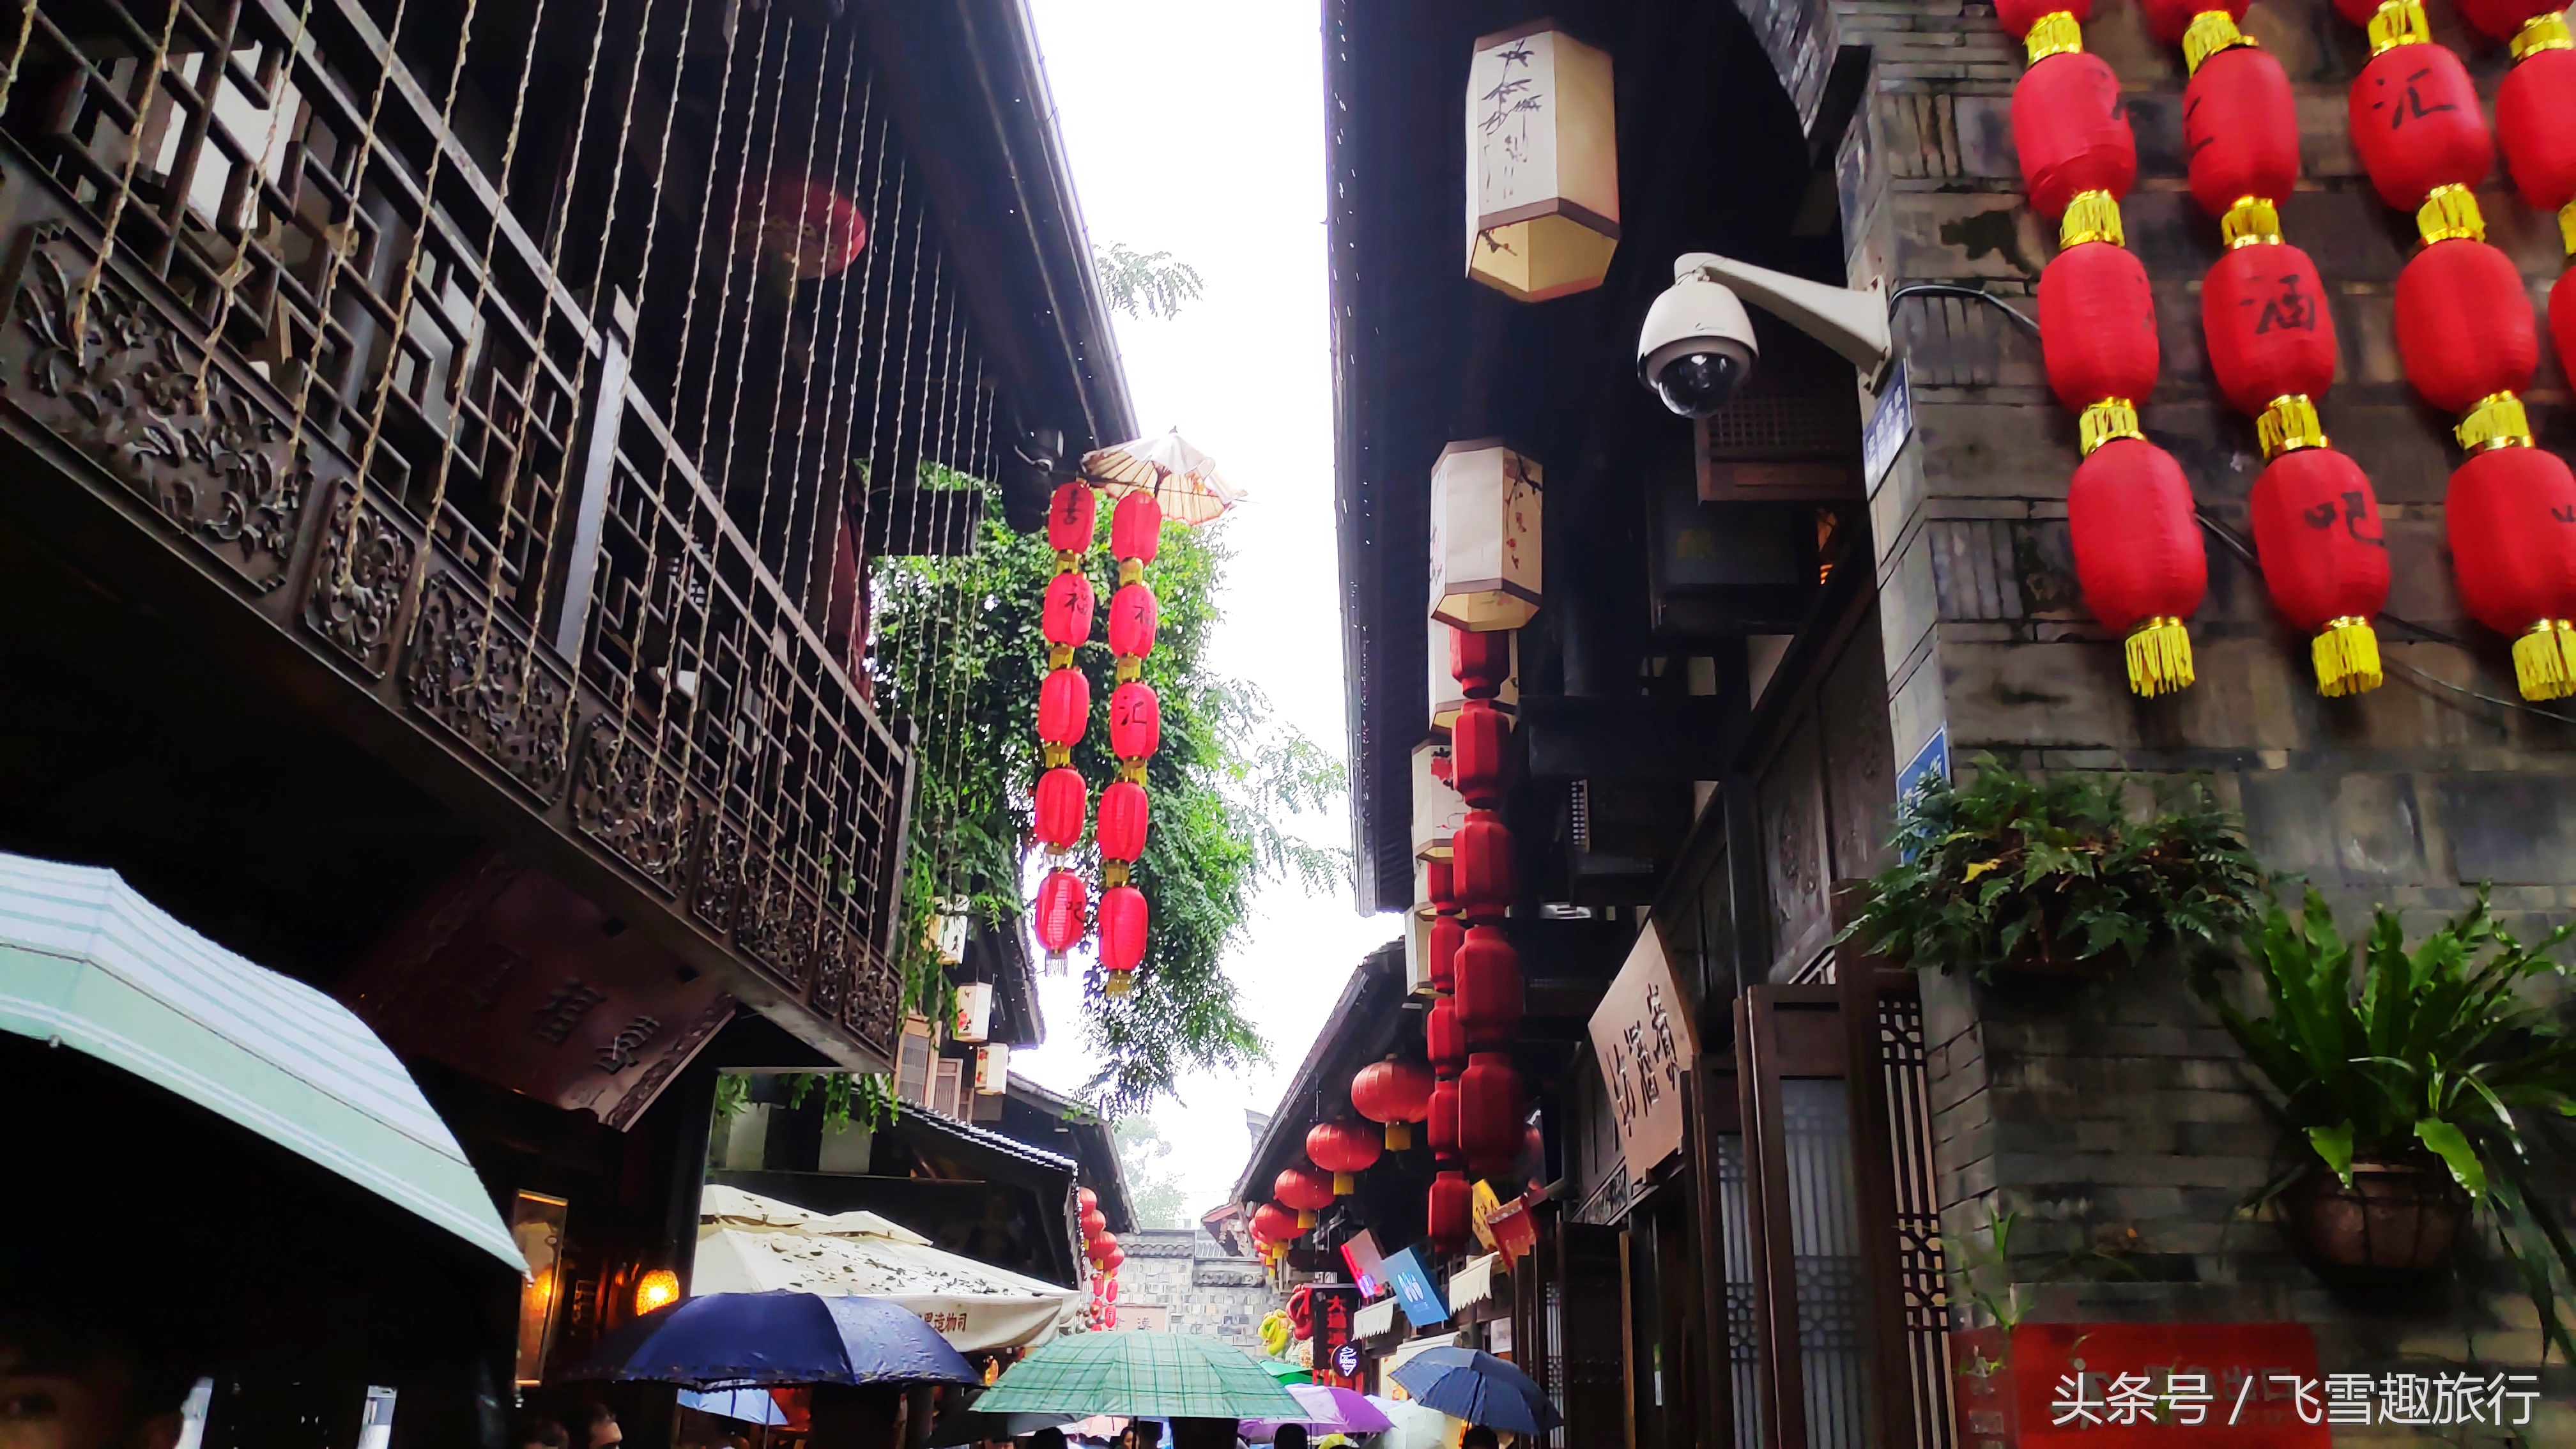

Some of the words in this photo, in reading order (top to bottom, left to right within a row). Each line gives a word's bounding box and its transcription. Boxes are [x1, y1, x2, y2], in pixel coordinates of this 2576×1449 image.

[2372, 68, 2458, 130] 汇
[2304, 491, 2383, 547] 吧
[1119, 695, 1148, 726] 汇
